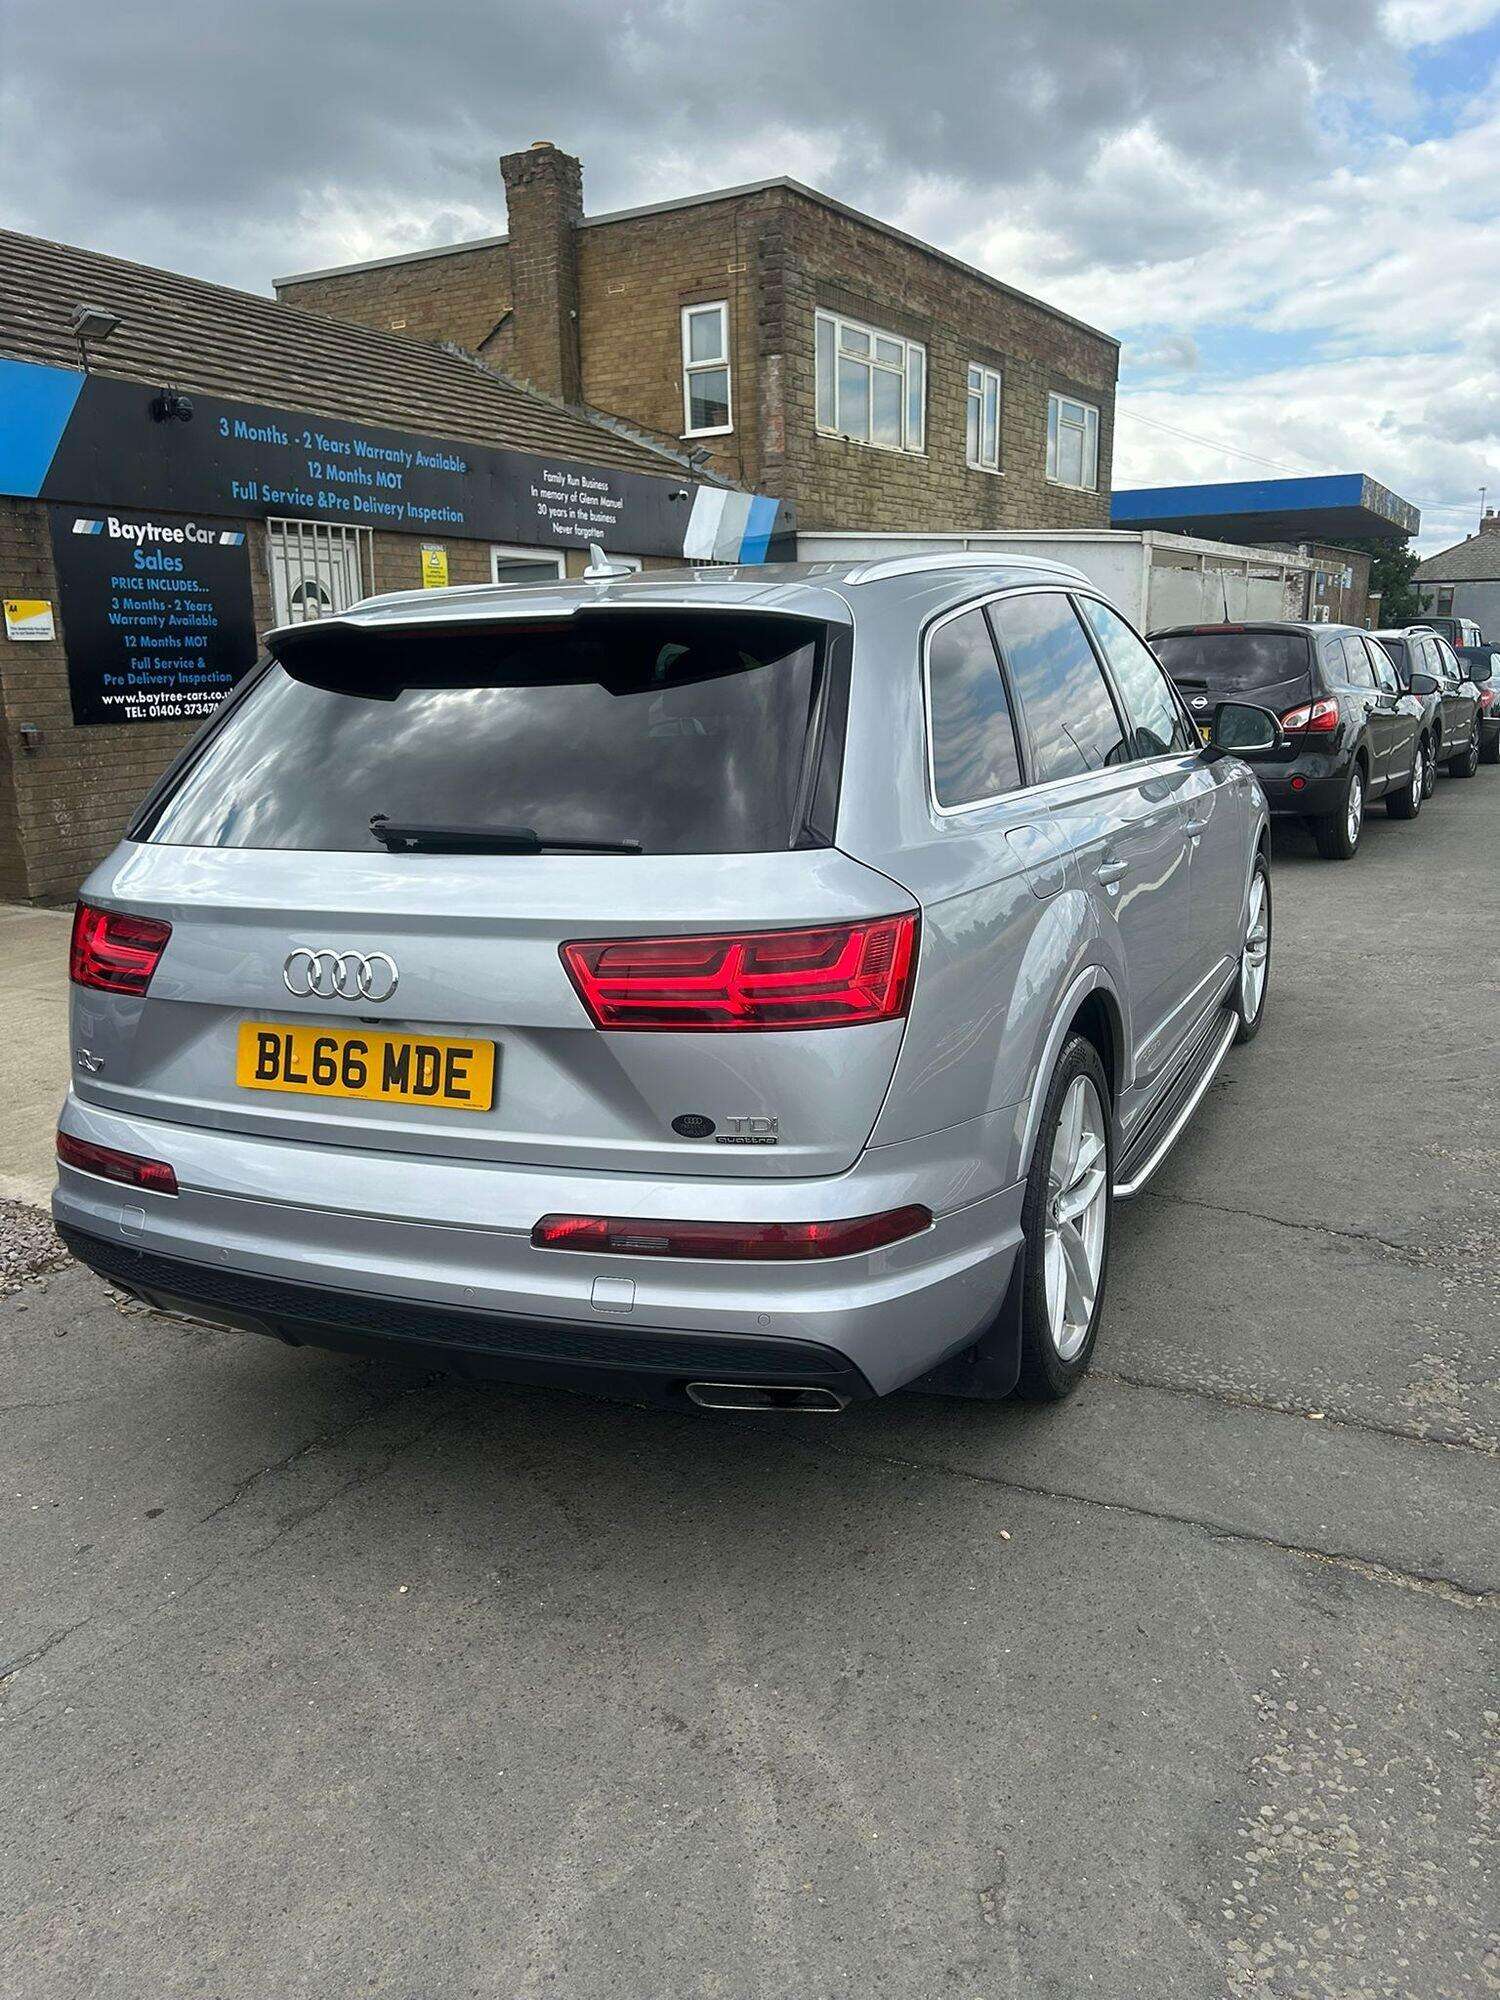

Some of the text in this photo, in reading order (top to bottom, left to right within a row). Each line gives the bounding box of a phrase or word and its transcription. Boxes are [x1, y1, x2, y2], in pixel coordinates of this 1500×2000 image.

[219, 417, 229, 437] 3
[234, 420, 288, 446] Months
[303, 431, 312, 449] 2
[315, 433, 350, 455] Years
[353, 440, 412, 468] Warranty
[416, 451, 467, 473] Available
[307, 461, 402, 490] 12 Months MOT
[543, 470, 609, 491] Family Run Business
[231, 481, 257, 500] Full
[263, 485, 313, 507] Service
[353, 496, 404, 520] Delivery
[408, 506, 464, 525] Inspection
[530, 485, 623, 509] In memory of Glenn Manuel
[537, 503, 616, 524] 30 years in the business
[552, 522, 605, 539] Never forgotten
[133, 549, 184, 571] Sales
[111, 577, 144, 589] PRICE
[111, 597, 119, 609] 3
[123, 598, 165, 611] Months
[174, 599, 182, 611] 2
[184, 600, 213, 611] Years
[108, 613, 218, 628] Warranty Available
[124, 635, 208, 647] 12 Months MOT
[131, 657, 206, 669] Full Service &
[104, 670, 233, 687] Pre Delivery Inspection
[102, 687, 233, 705] www.baytree-cars.co.
[125, 706, 146, 718] TEL:
[149, 704, 181, 717] 01406
[255, 1032, 474, 1100] BL66 MDE
